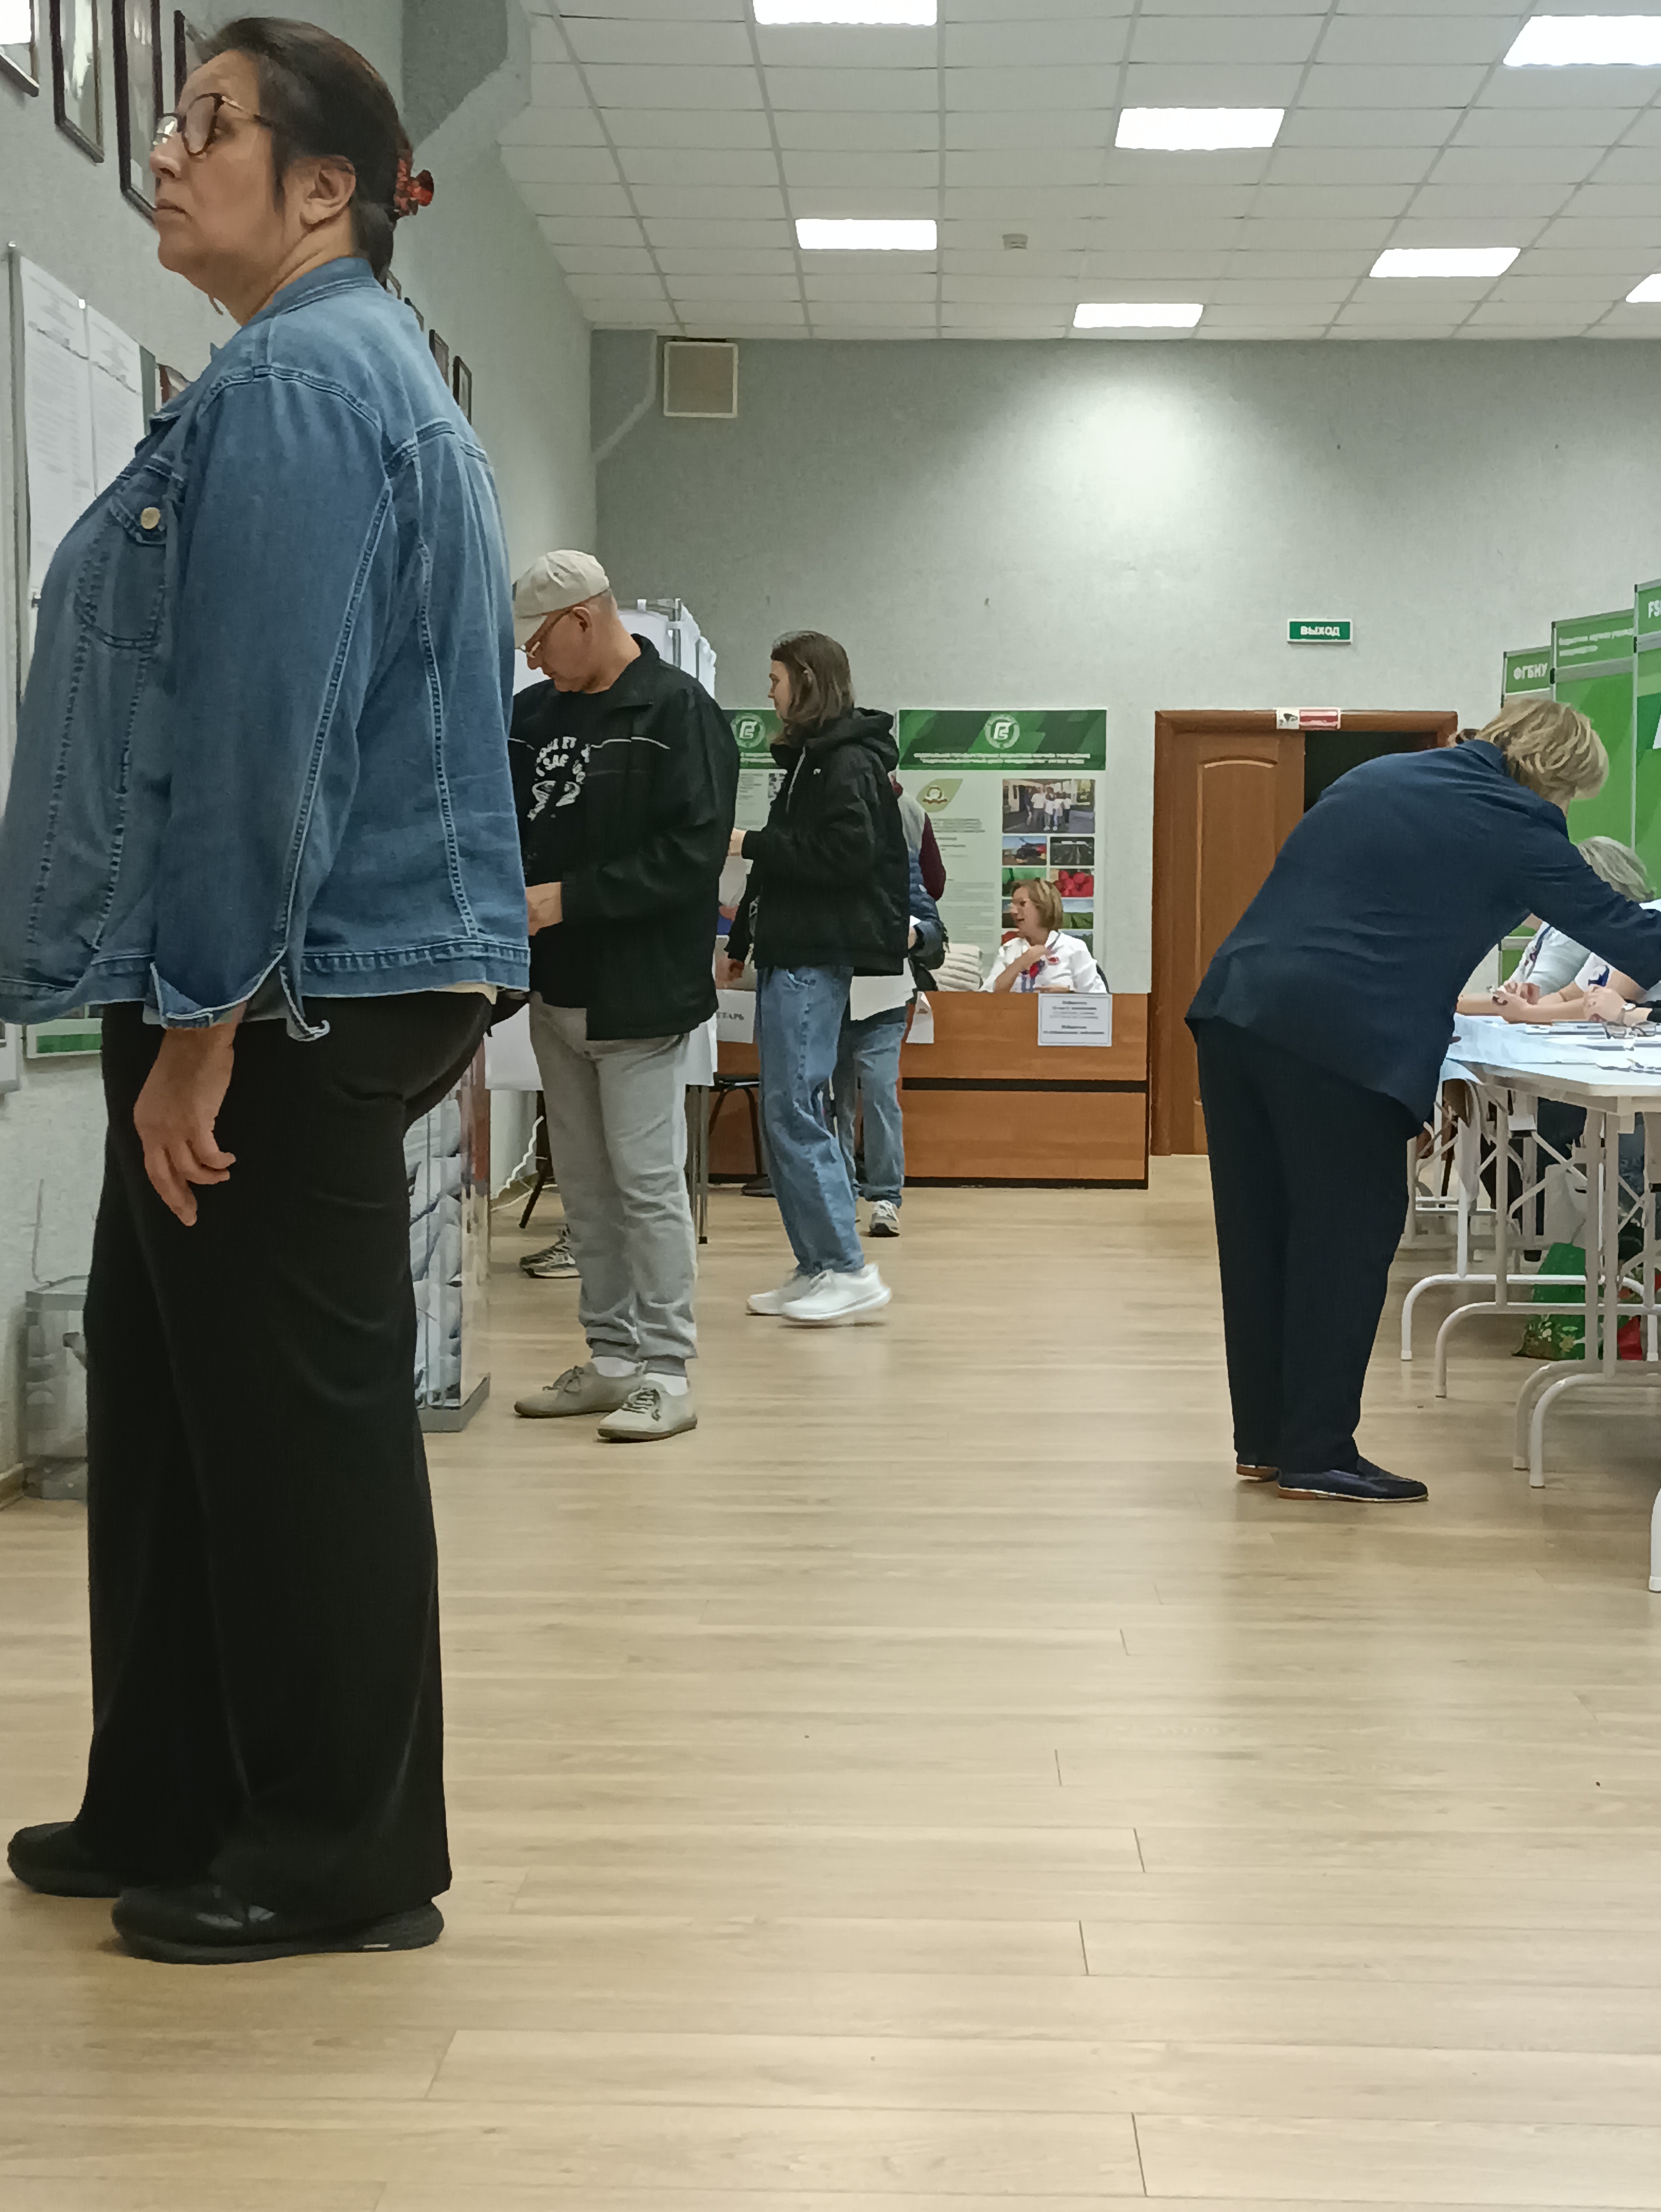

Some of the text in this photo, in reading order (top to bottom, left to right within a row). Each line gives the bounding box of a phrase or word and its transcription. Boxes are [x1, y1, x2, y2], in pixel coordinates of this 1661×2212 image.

[1648, 599, 1661, 619] FS
[1300, 626, 1340, 637] ВЫХОД
[1514, 663, 1548, 680] ФГБНУ
